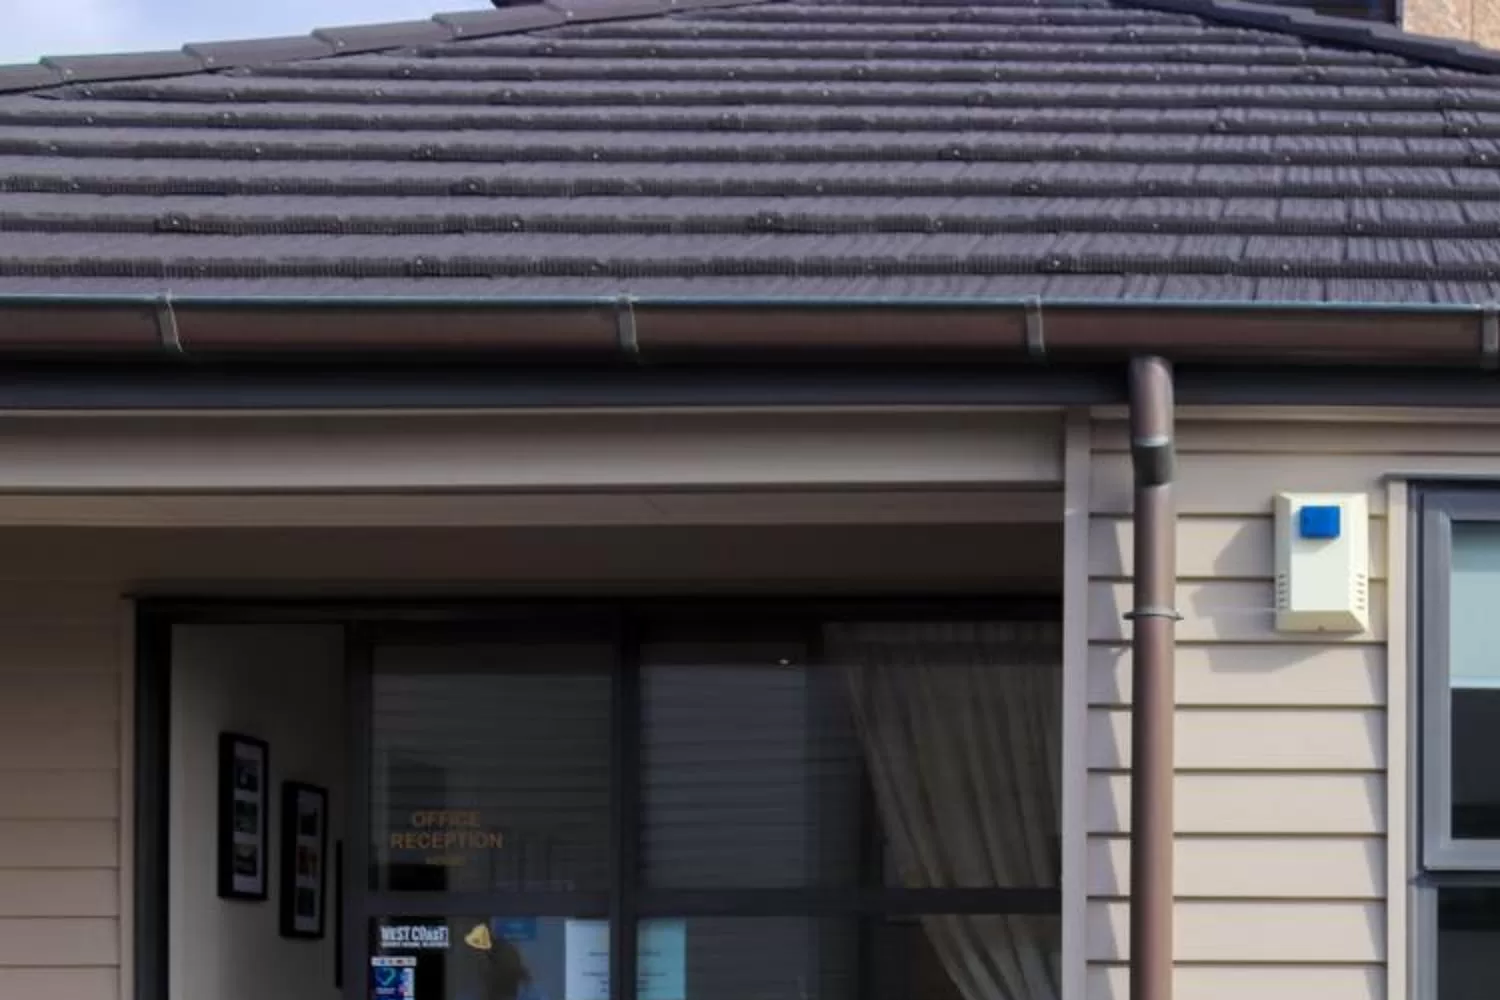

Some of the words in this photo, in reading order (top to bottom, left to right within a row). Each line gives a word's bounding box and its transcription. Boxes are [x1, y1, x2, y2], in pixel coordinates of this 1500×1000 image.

[412, 811, 481, 828] OFFICE
[390, 832, 503, 848] RECEPTION
[380, 925, 411, 941] WEST
